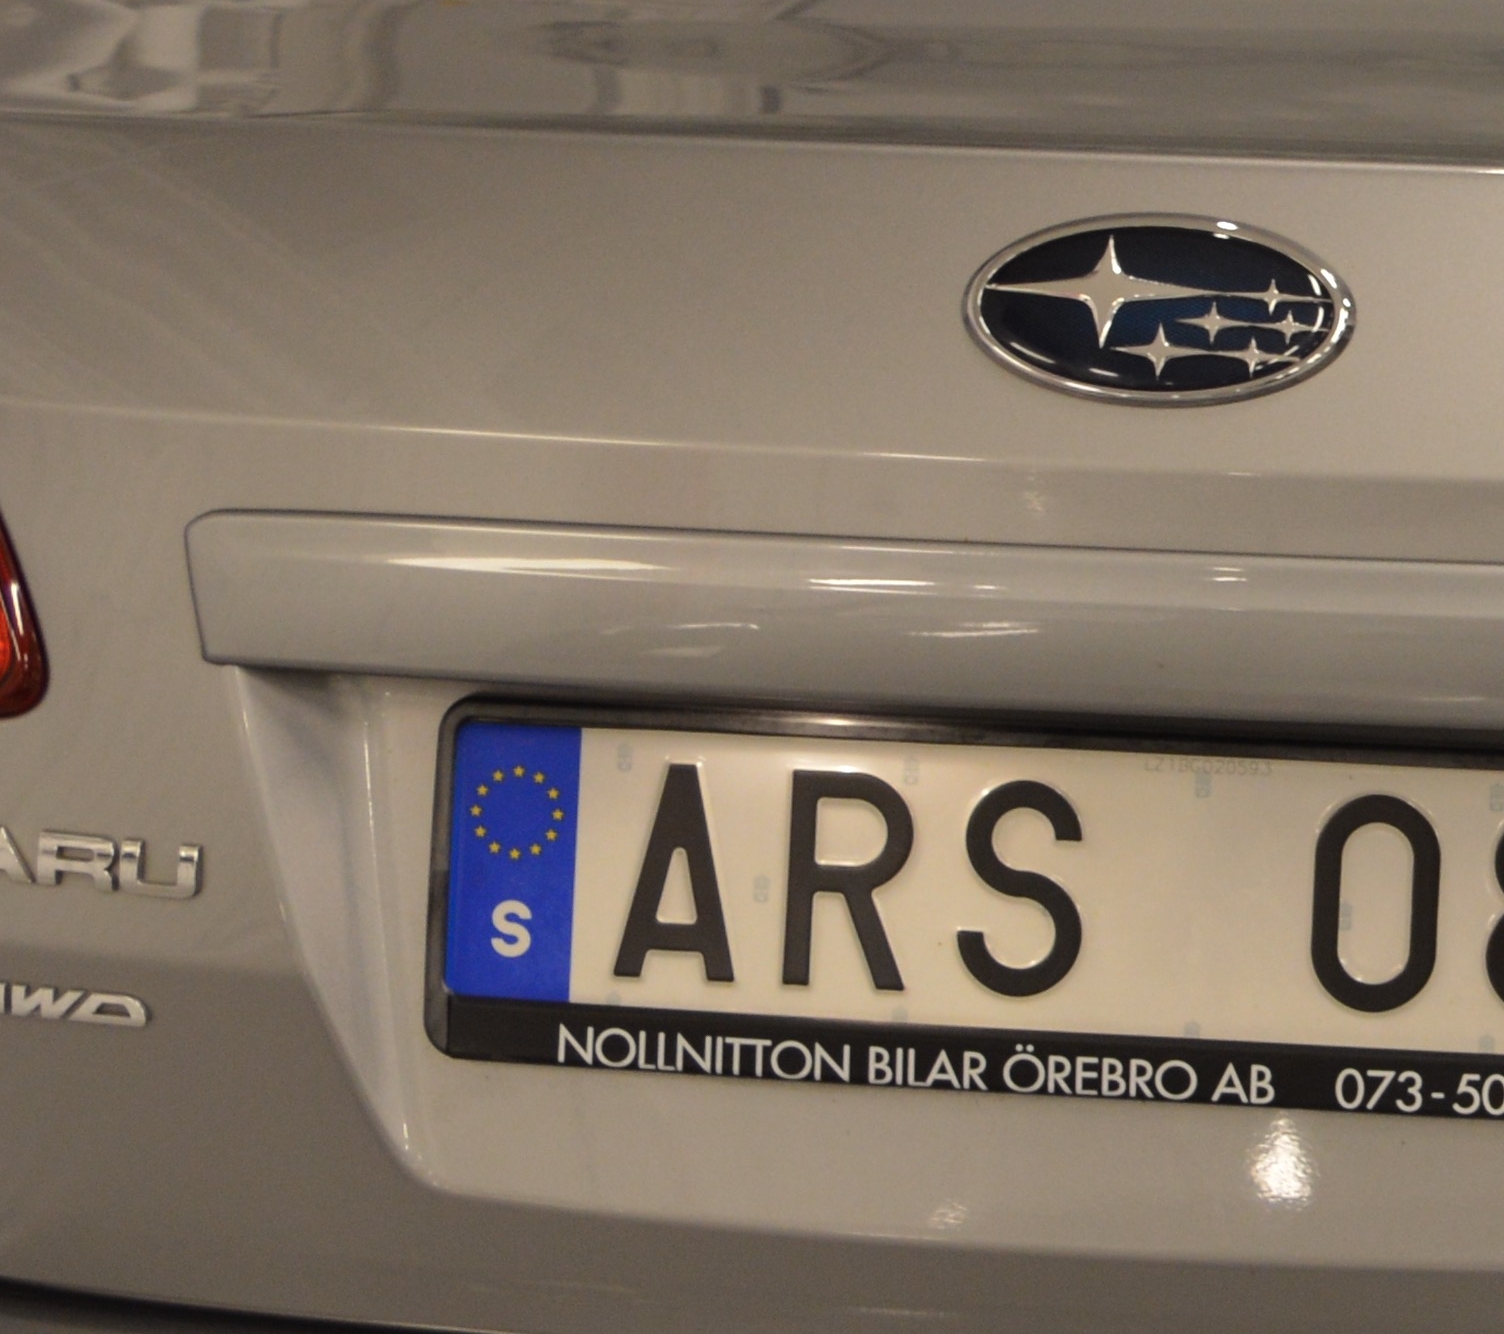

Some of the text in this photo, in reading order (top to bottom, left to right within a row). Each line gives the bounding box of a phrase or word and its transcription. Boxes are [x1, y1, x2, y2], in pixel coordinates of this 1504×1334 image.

[613, 763, 1083, 998] ARS
[491, 900, 532, 958] S
[557, 1022, 851, 1083] NOLLNITTON
[867, 1045, 989, 1092] BILAR
[1002, 1043, 1198, 1100] ÖREBRO
[1211, 1062, 1276, 1105] AB
